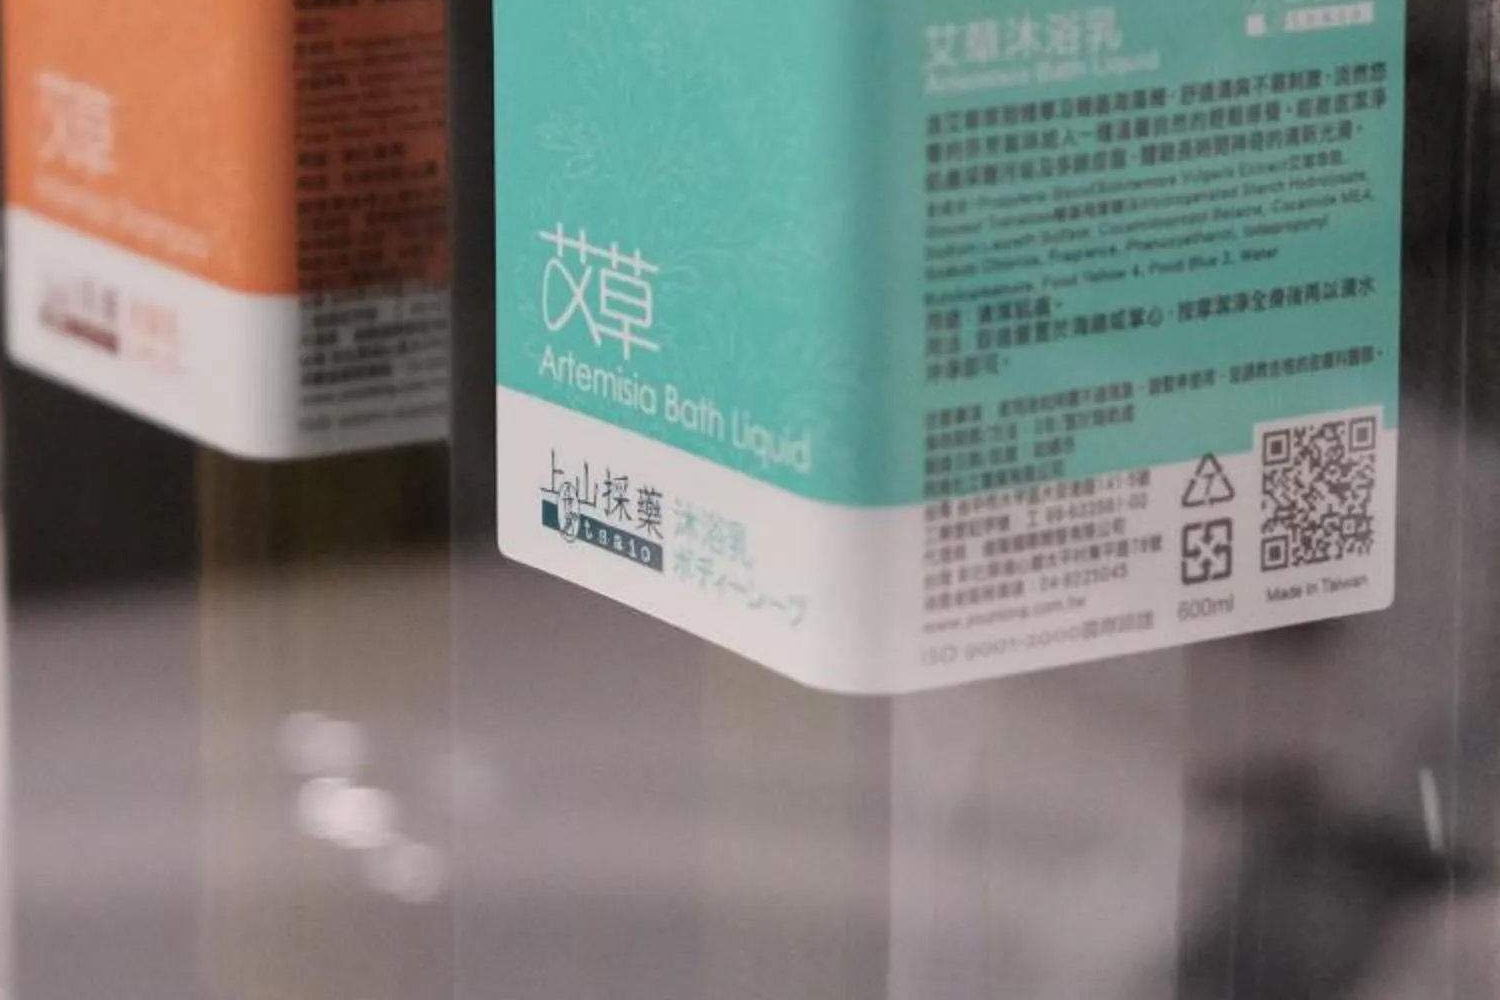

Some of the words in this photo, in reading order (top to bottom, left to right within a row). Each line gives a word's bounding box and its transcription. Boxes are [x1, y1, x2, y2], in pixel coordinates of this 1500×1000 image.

[538, 344, 658, 416] Artemisia
[663, 383, 725, 443] Bath
[730, 407, 812, 475] Liquid
[540, 448, 664, 540] 上山採藥
